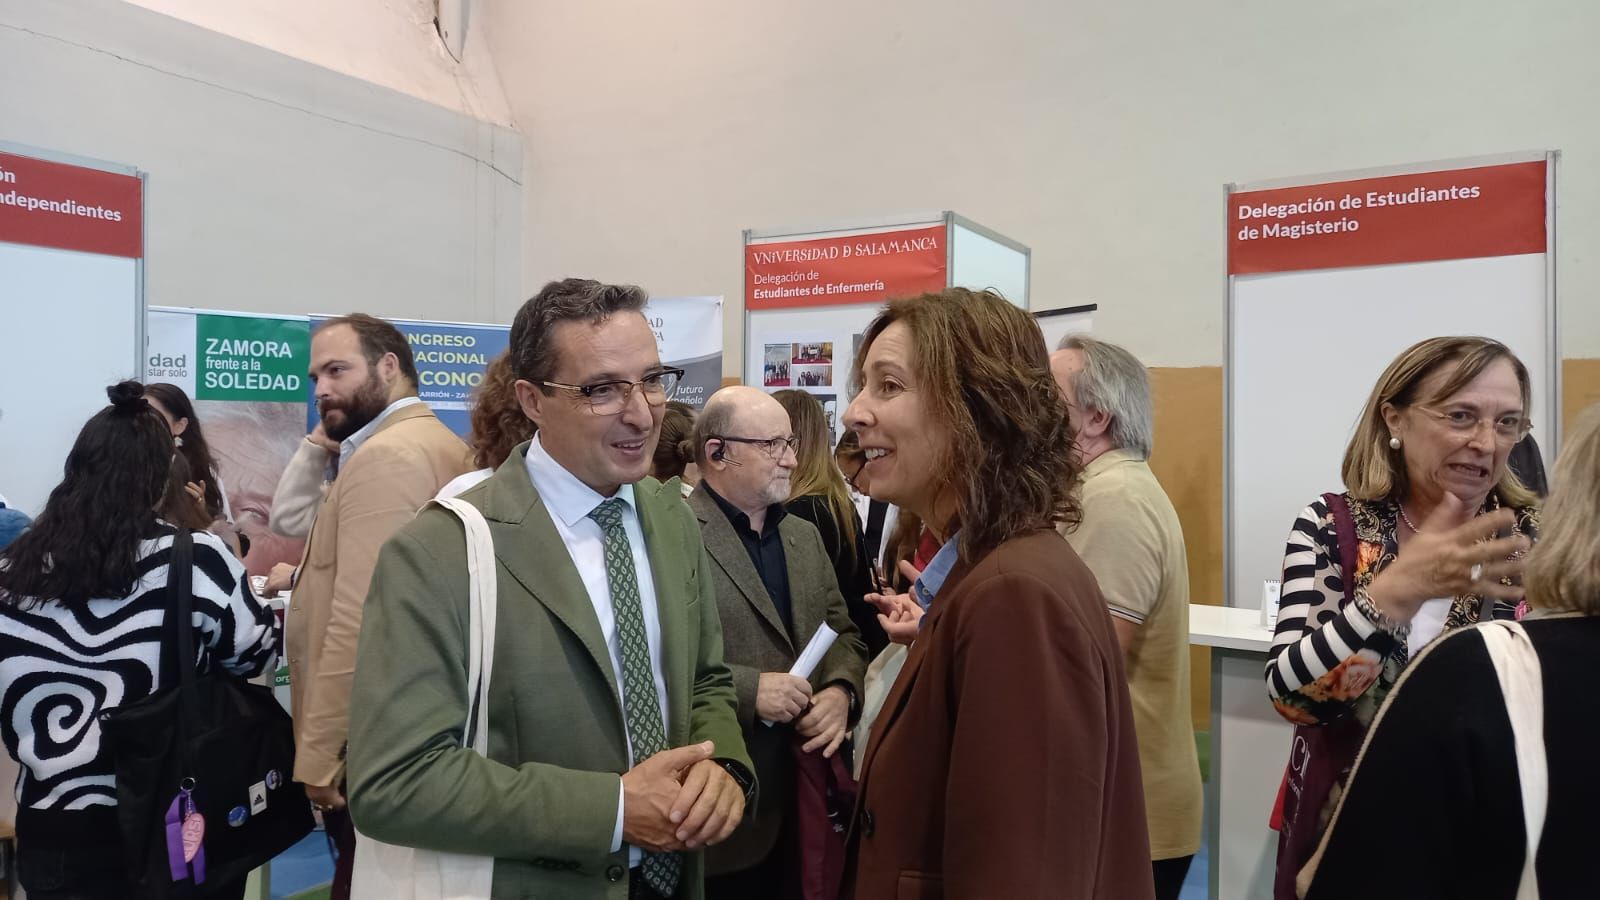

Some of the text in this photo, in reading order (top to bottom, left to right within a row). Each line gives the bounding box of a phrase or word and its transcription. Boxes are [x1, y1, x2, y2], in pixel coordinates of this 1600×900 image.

[1238, 183, 1480, 220] Delegación de Estudiantes
[1238, 217, 1359, 241] de Magisterio
[855, 236, 938, 258] SALAMANCA
[754, 269, 820, 285] Delegación de
[753, 280, 884, 299] Estudiantes de Enfermería
[205, 338, 293, 358] ZAMORA
[407, 333, 476, 348] NGRESO
[149, 353, 186, 368] dad
[205, 356, 261, 371] frente a la
[415, 351, 488, 365] ACIONAL
[148, 367, 188, 378] star solo
[420, 370, 483, 387] CONO
[204, 371, 300, 391] SOLEDAD
[419, 390, 450, 398] ARRIÓN
[675, 385, 704, 397] futuro
